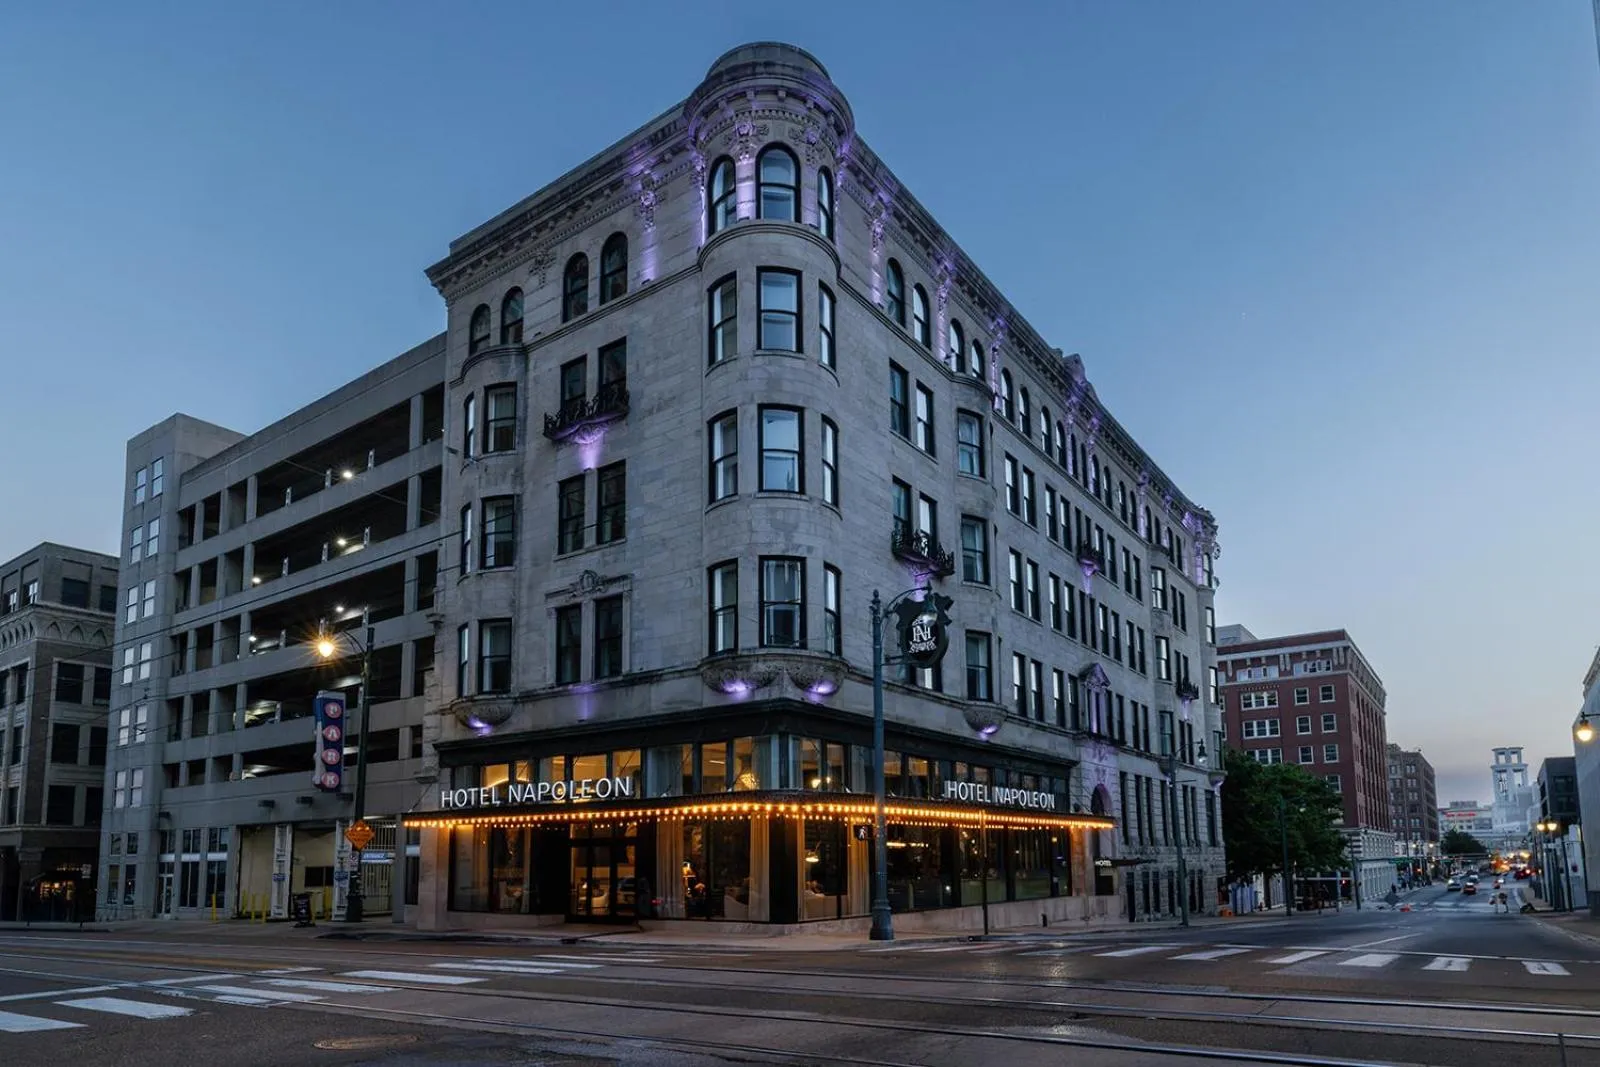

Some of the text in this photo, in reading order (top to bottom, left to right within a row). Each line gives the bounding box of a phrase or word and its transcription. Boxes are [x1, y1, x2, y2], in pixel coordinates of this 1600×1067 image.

[441, 776, 631, 808] HOTEL NAPOLEON
[944, 780, 1055, 810] HOTEL NAPOLEON
